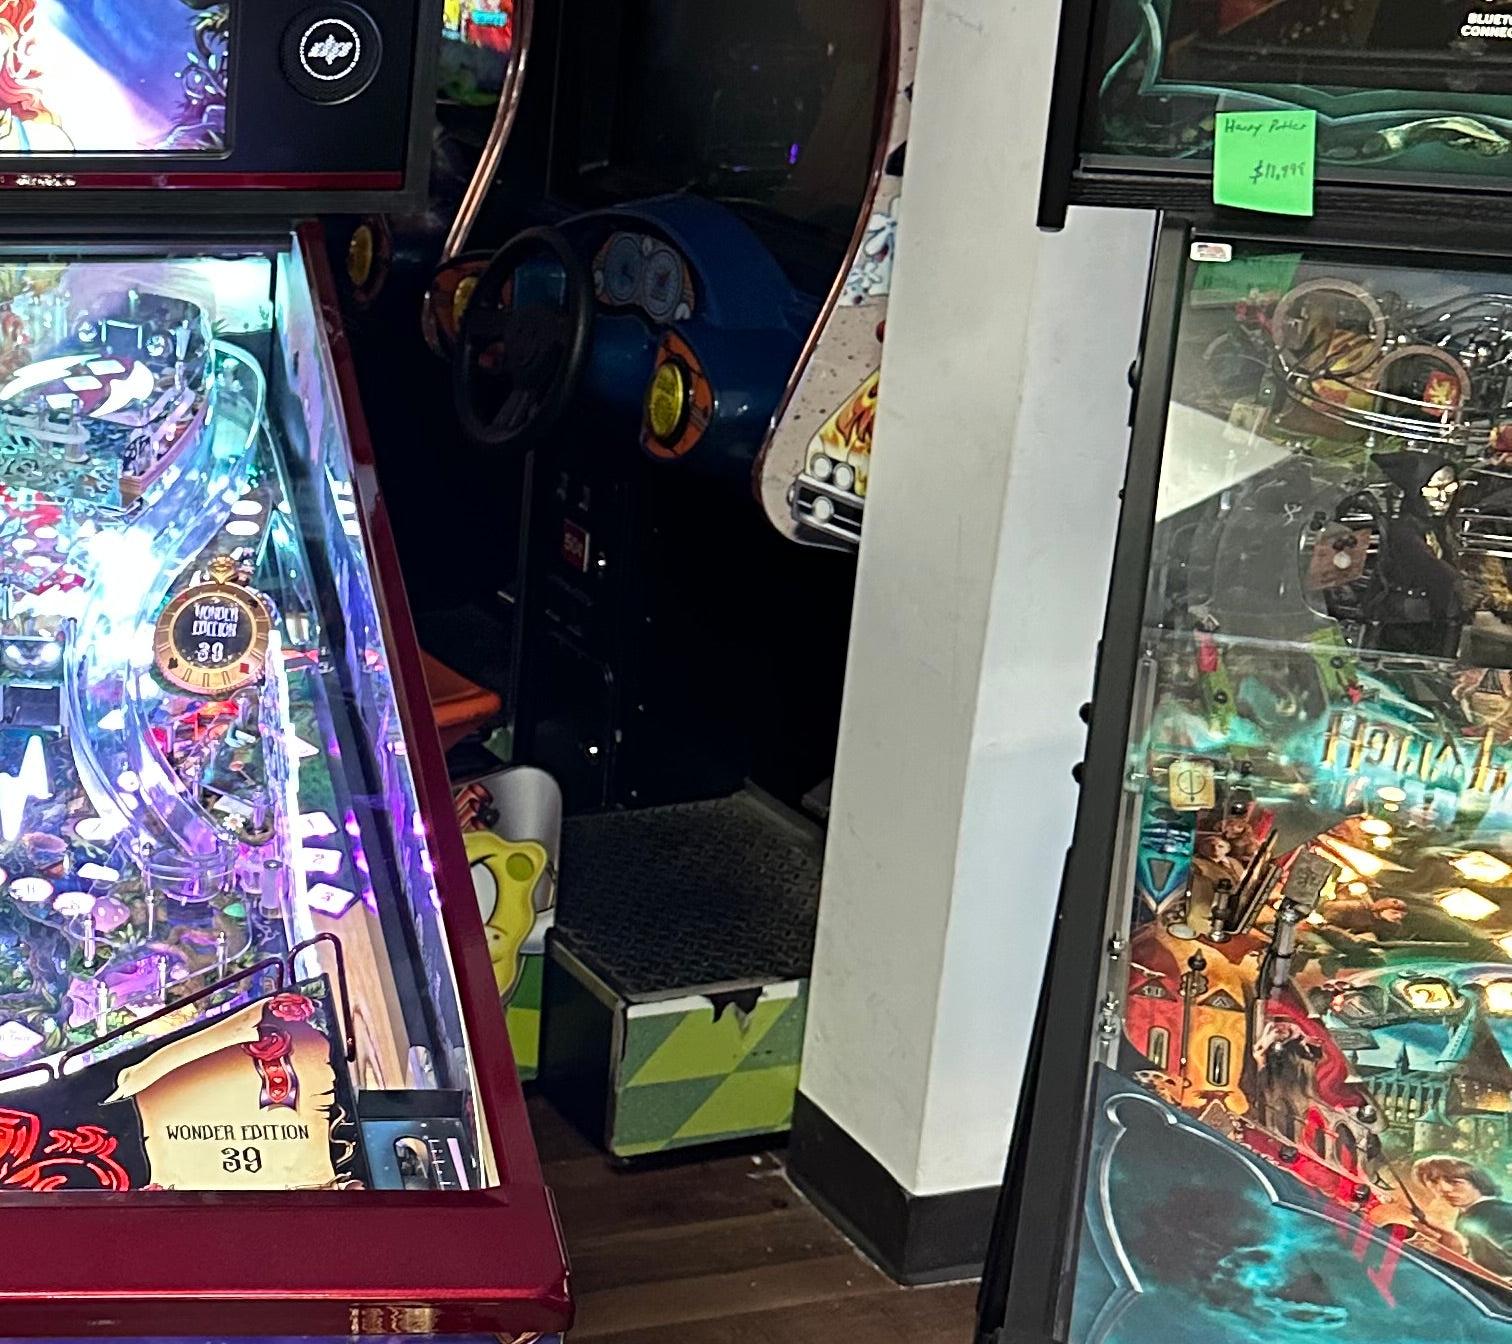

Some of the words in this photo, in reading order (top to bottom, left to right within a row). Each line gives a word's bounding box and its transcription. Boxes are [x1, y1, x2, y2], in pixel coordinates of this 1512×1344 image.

[1224, 118, 1264, 137] Harry
[166, 1124, 236, 1141] WONDER
[241, 1124, 310, 1141] EDITION
[220, 1146, 263, 1174] 39
